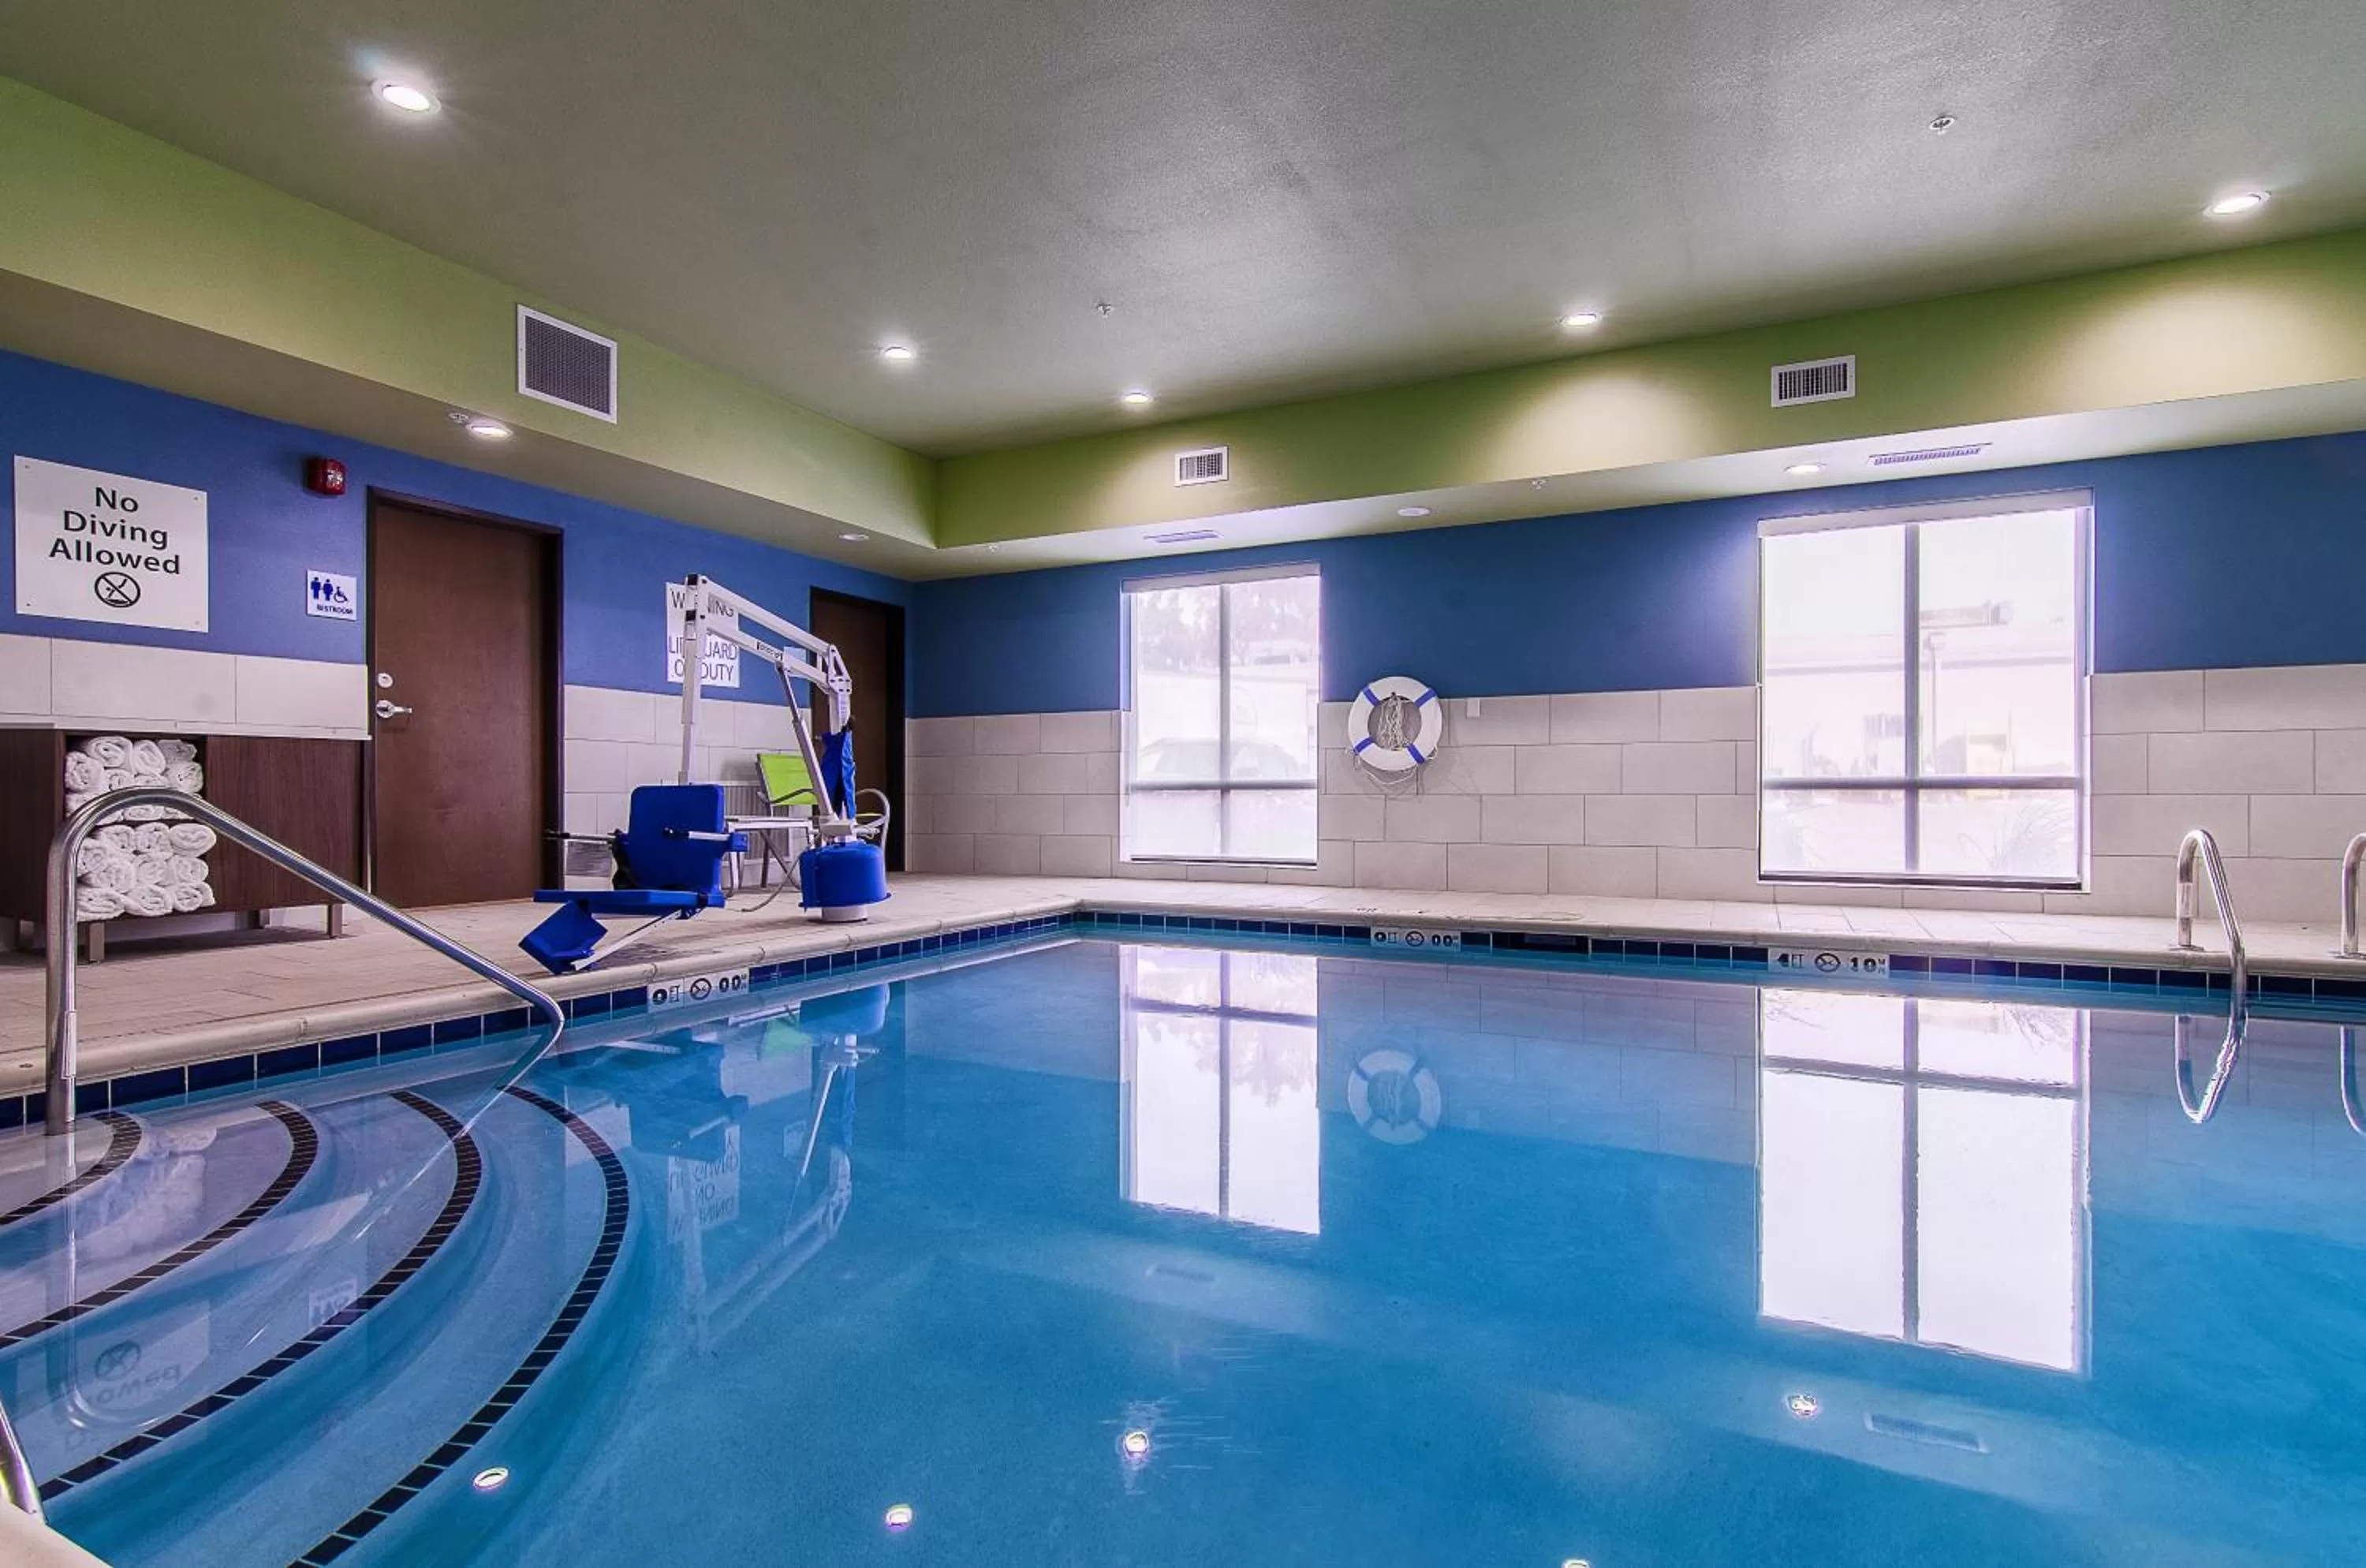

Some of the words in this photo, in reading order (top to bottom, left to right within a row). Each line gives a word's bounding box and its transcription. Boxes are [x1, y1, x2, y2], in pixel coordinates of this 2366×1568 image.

[95, 486, 139, 513] No
[63, 510, 169, 551] Diving
[49, 537, 181, 575] Allowed
[671, 590, 734, 618] WING
[668, 637, 737, 661] LIUARD
